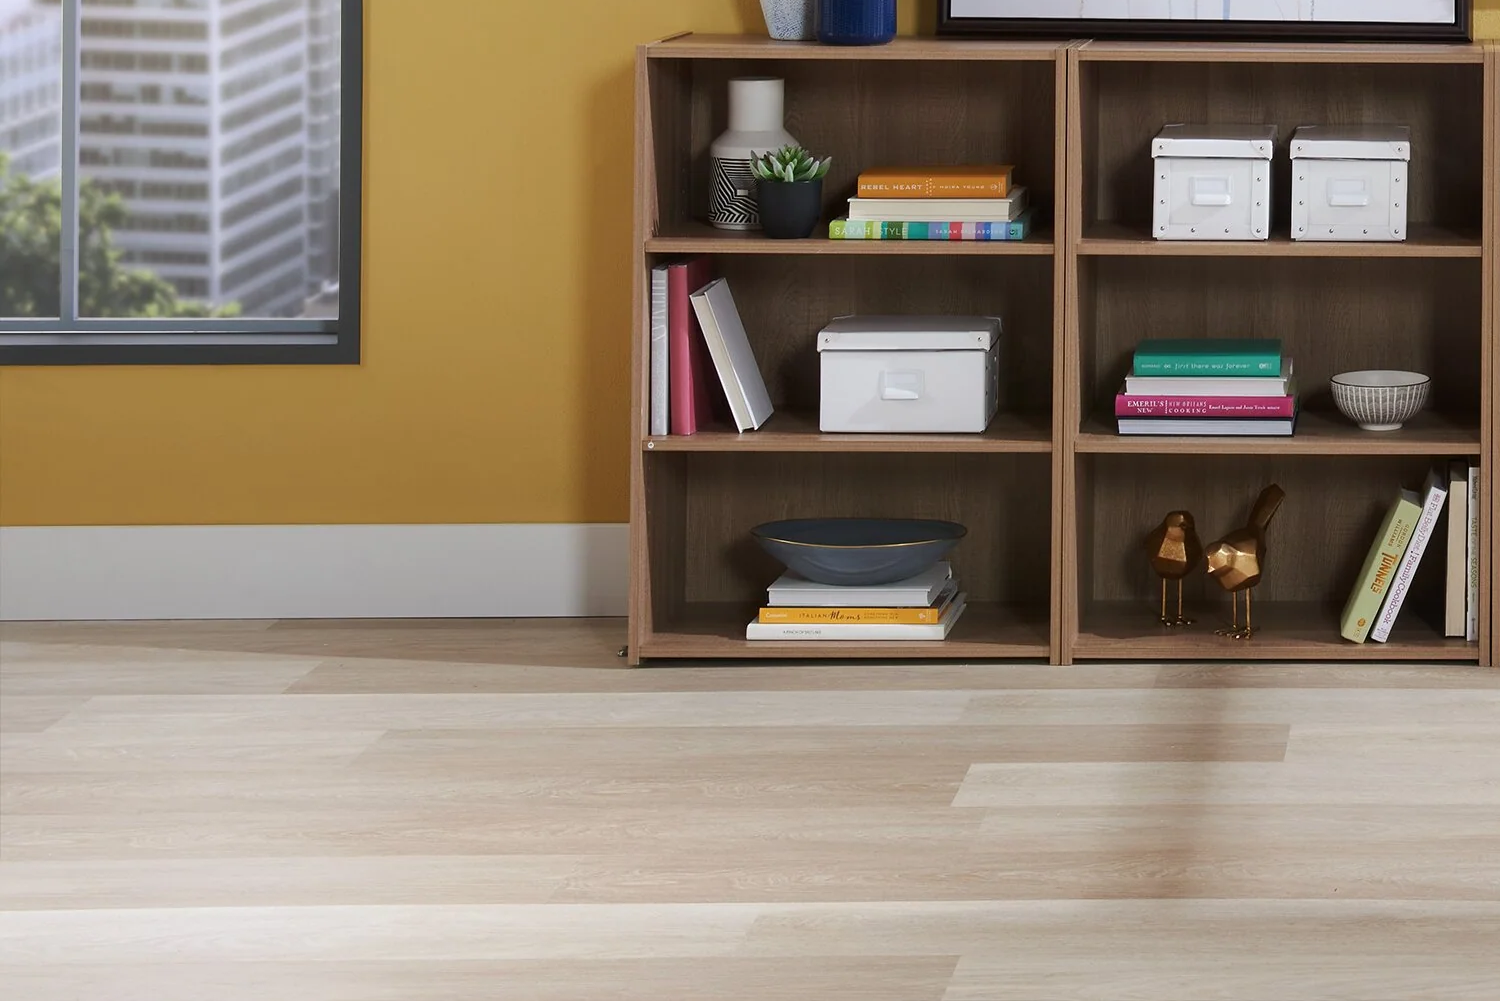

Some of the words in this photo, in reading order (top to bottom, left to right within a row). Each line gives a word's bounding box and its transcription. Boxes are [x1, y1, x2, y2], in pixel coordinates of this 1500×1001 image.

[834, 227, 870, 236] SARAH
[879, 227, 909, 236] STYLE
[1175, 362, 1189, 371] first
[1225, 363, 1251, 371] forever
[1426, 502, 1439, 517] Flat
[1388, 518, 1402, 547] WILLIAMS
[1396, 523, 1410, 548] GORDON
[1419, 516, 1432, 536] Belly
[1470, 517, 1478, 537] TASTE
[1370, 551, 1398, 594] TUNNELS
[1399, 554, 1417, 584] Family
[1470, 557, 1478, 588] SEASONS
[828, 609, 860, 621] Moms
[1383, 583, 1406, 625] Cookbook
